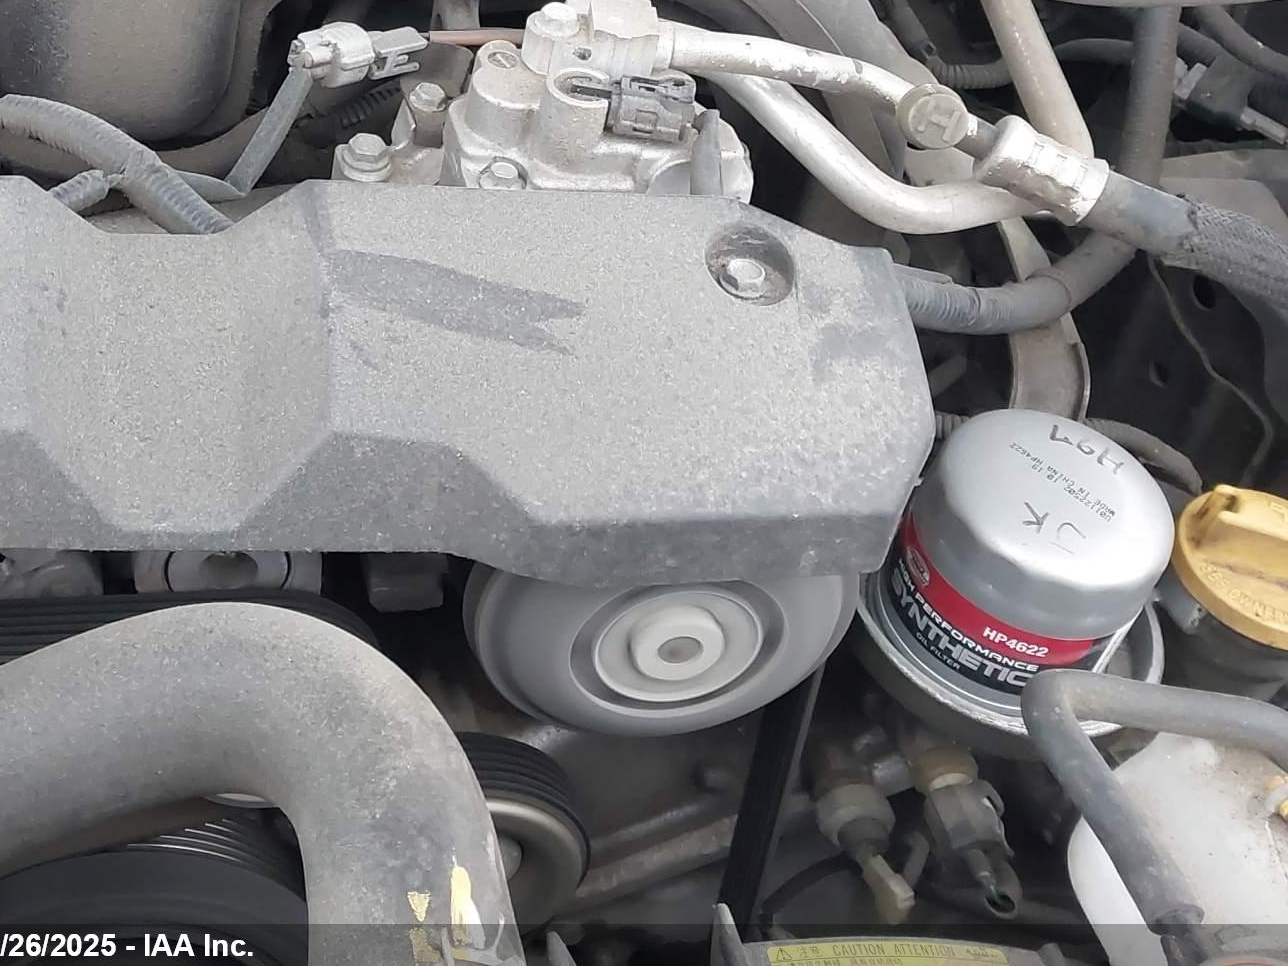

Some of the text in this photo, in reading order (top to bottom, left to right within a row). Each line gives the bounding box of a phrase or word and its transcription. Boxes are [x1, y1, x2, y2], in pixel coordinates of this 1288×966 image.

[1046, 465, 1075, 486] CHINA
[891, 566, 1034, 687] SYNTHETIC
[914, 591, 1040, 672] PERFORMANCE
[982, 626, 1049, 658] HP4622
[916, 632, 961, 671] OIL FILTER
[832, 944, 886, 957] CAUTION
[893, 943, 956, 958] ATTENTION
